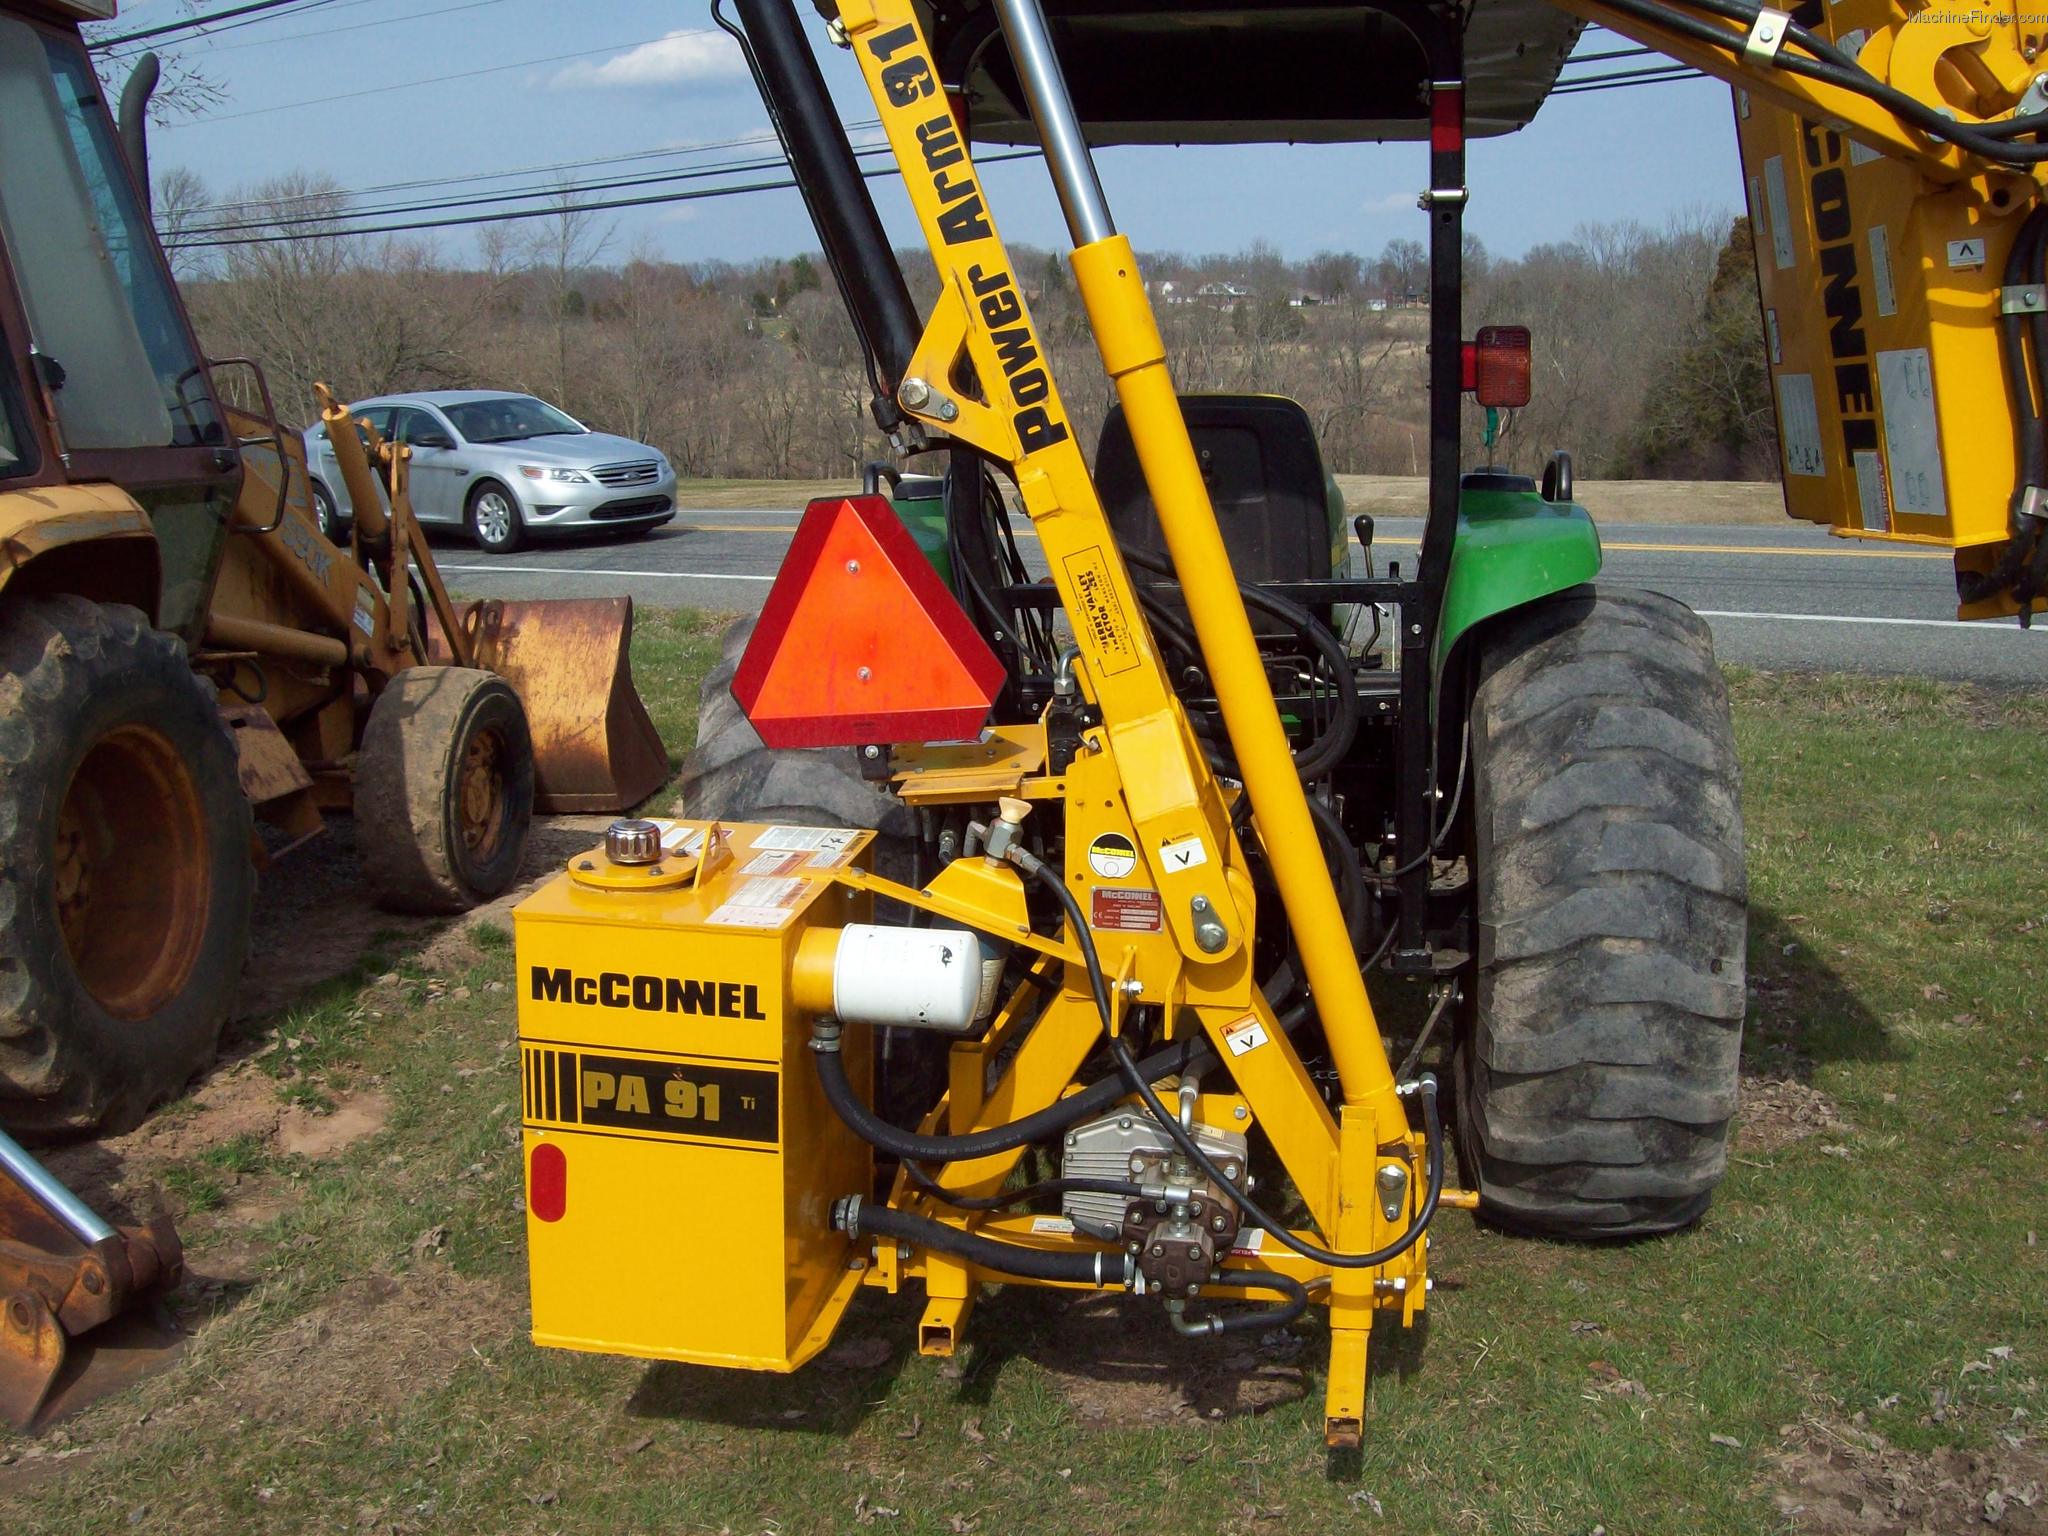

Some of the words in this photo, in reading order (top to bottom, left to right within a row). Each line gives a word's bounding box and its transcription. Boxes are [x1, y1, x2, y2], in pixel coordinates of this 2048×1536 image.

[868, 22, 936, 108] 91
[916, 113, 993, 246] Arm
[968, 264, 1069, 455] Power
[1076, 572, 1097, 612] VALLEY
[531, 966, 767, 1022] McCONNEL
[583, 1070, 651, 1114] PA
[664, 1080, 720, 1122] 91
[740, 1096, 756, 1110] Ti
